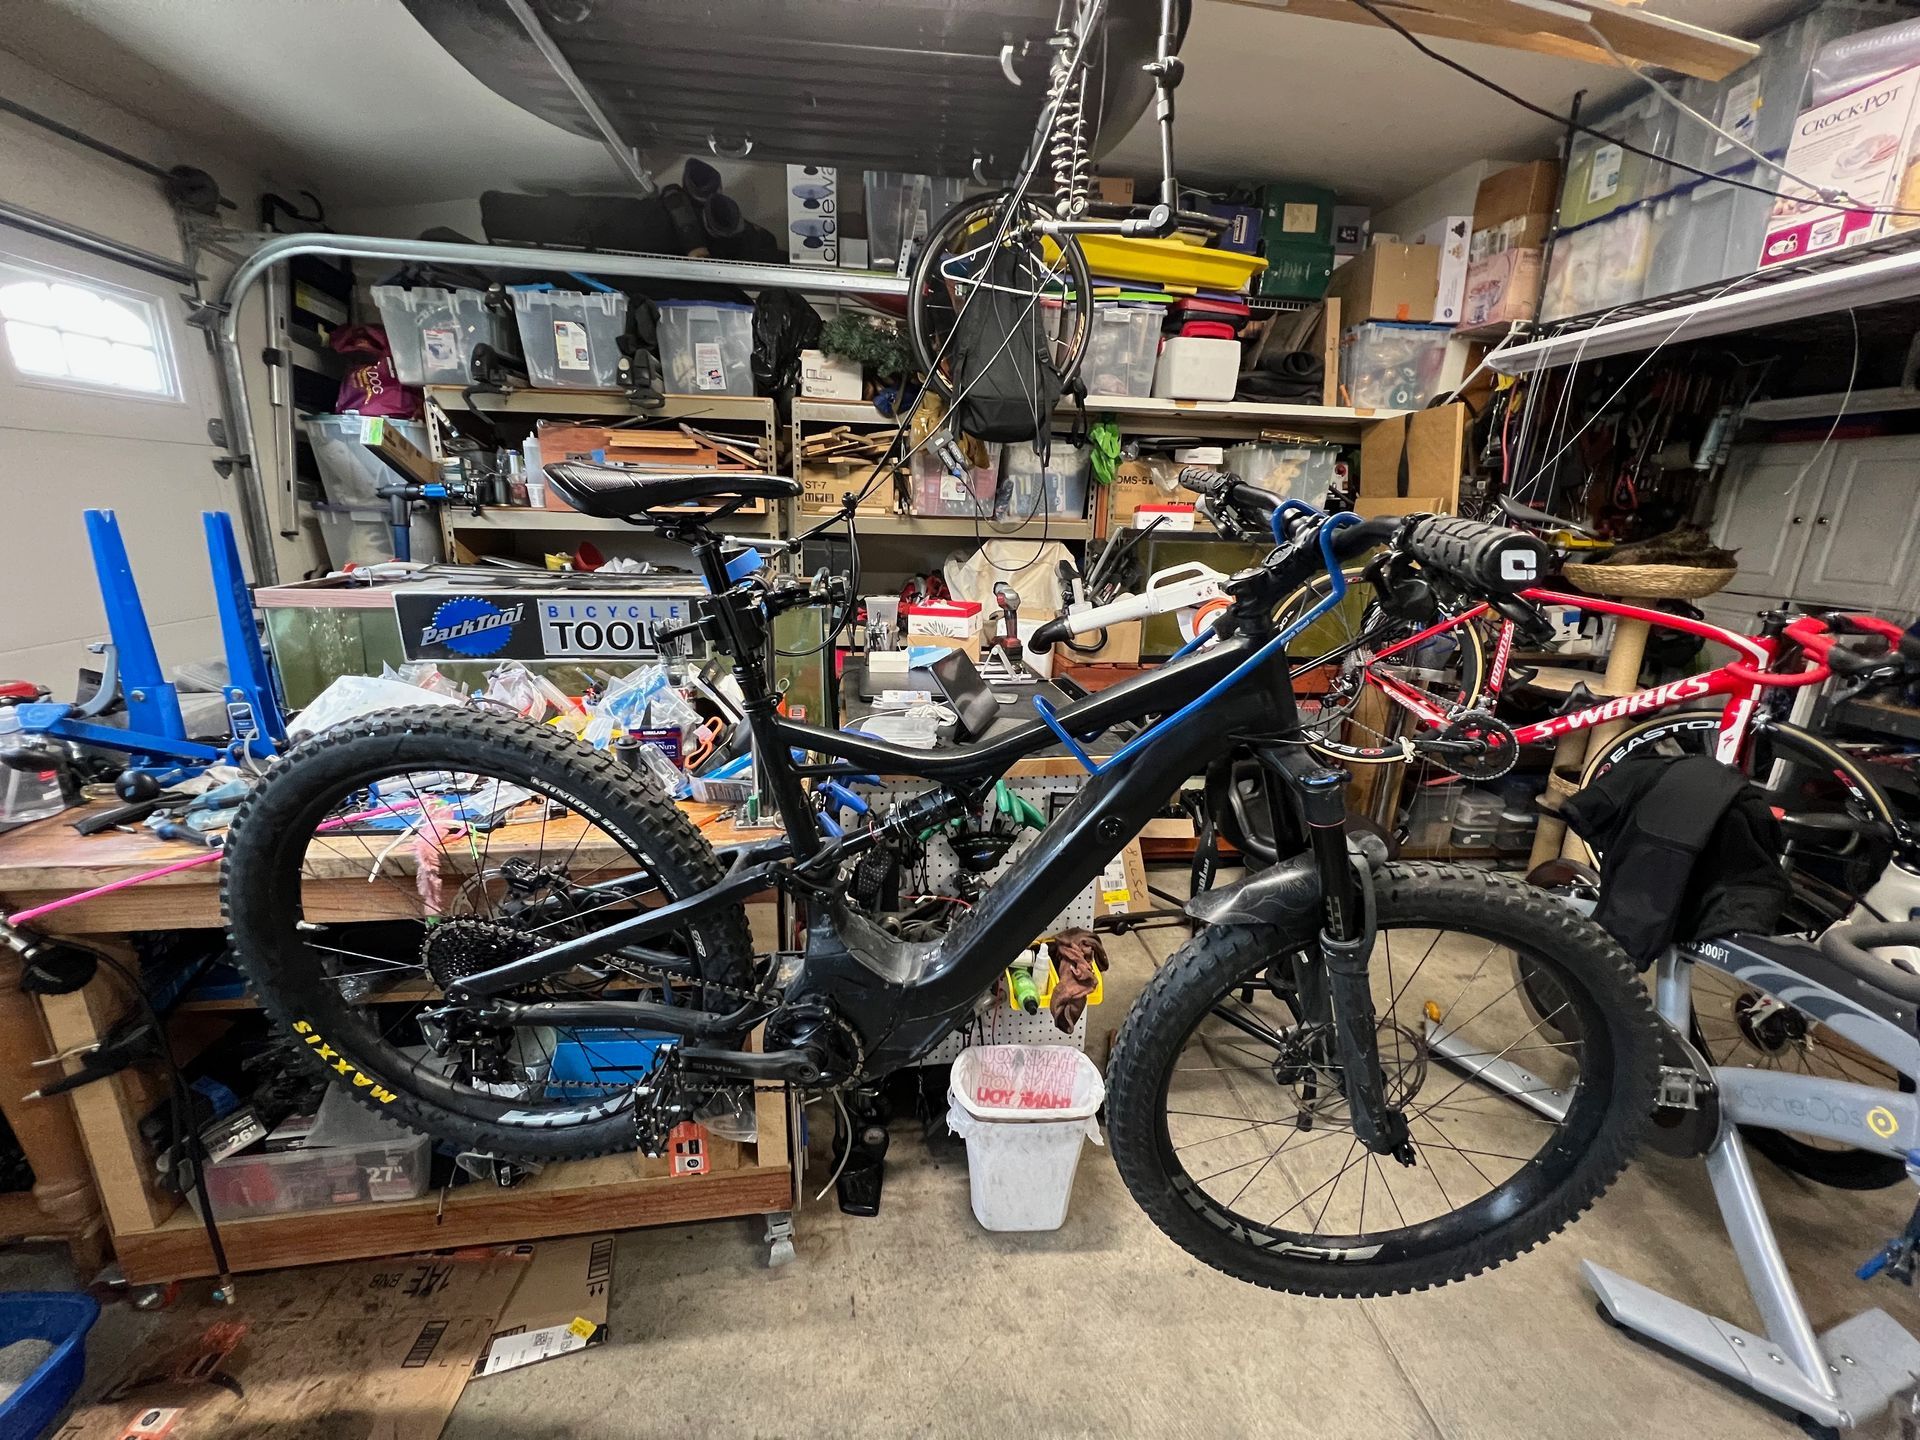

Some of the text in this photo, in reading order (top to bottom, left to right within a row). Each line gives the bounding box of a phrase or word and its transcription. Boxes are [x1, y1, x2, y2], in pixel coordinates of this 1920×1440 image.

[366, 371, 384, 394] DOG
[804, 480, 827, 489] ST-7
[548, 606, 680, 618] BICYCLE
[550, 621, 657, 650] TOOL
[1532, 673, 1711, 740] S-WORKS
[1698, 941, 1730, 964] 300PT
[292, 1020, 398, 1104] MAXXIS
[227, 1124, 258, 1149] 26"
[367, 1165, 403, 1183] 27"
